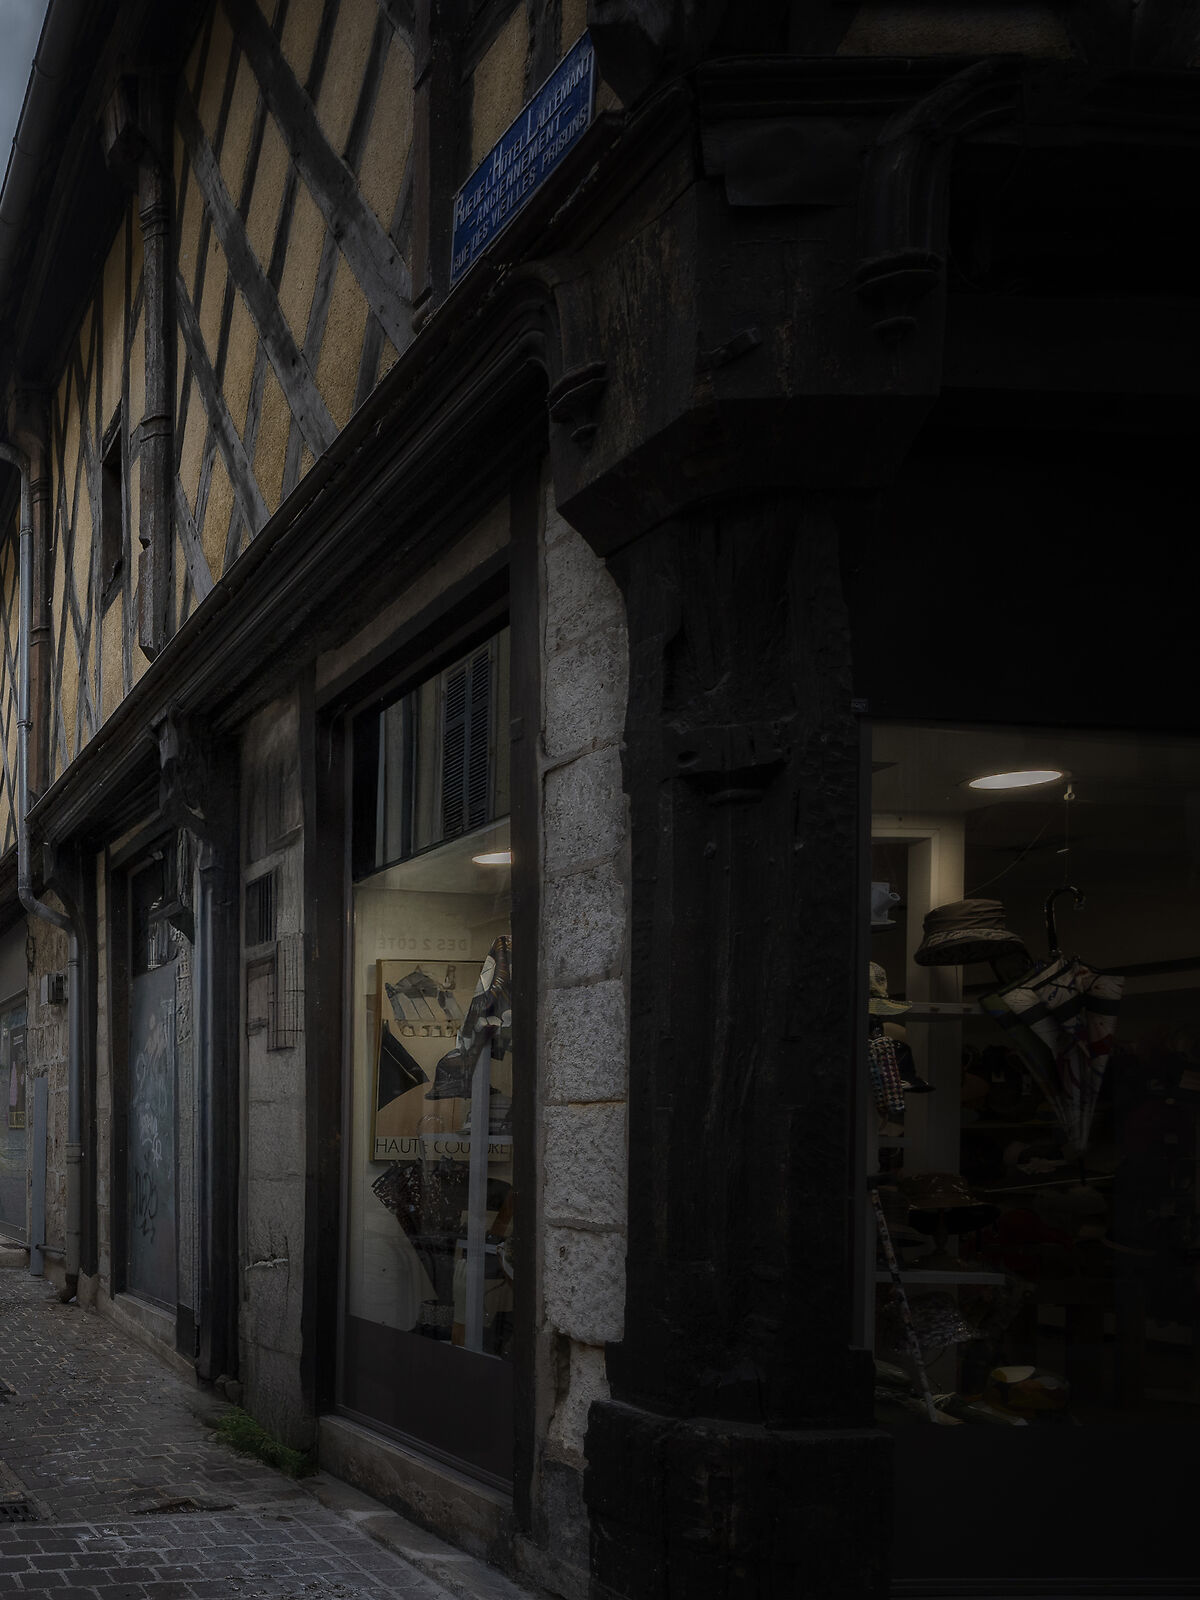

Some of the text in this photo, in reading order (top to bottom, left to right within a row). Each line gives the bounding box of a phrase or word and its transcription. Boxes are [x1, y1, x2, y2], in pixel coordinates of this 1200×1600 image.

[453, 103, 588, 274] RUE DES VIEILLES PRISONS
